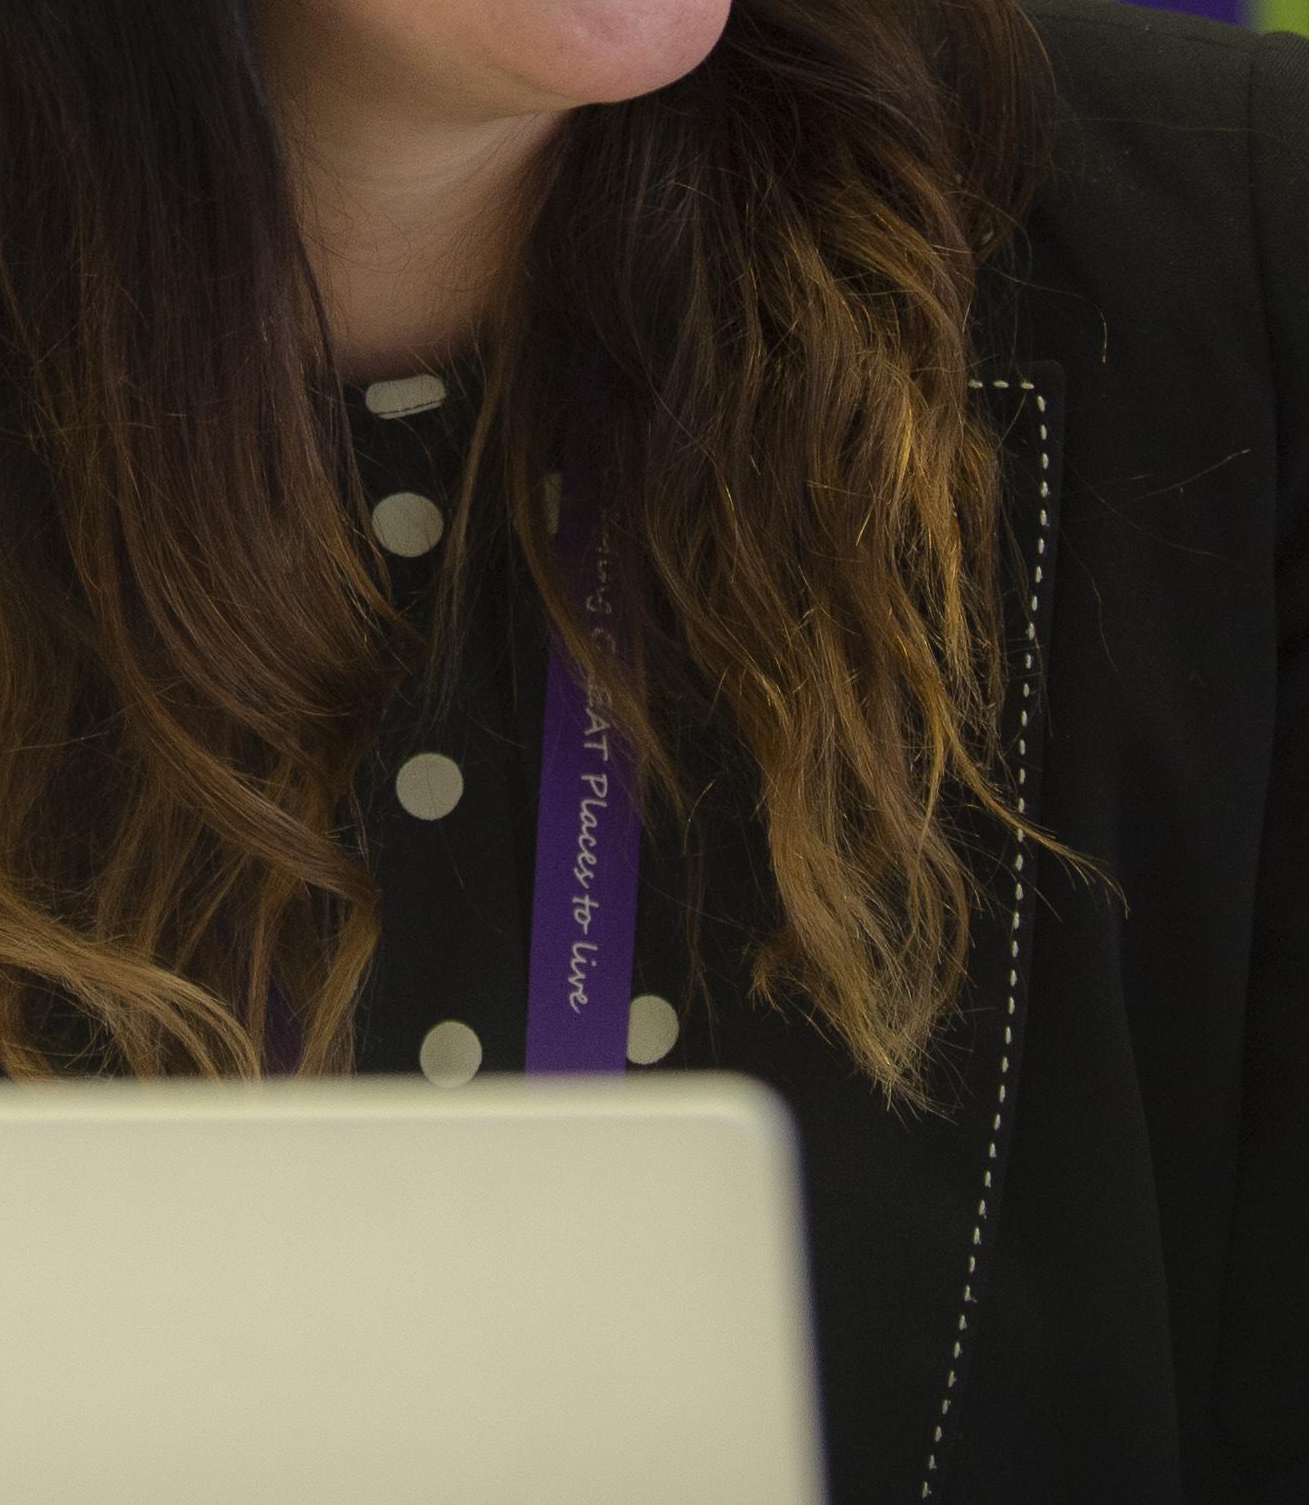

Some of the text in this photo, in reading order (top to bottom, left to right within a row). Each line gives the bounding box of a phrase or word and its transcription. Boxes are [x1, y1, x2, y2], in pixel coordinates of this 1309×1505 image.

[572, 773, 609, 889] Places
[572, 892, 600, 936] to
[566, 936, 599, 1015] live
